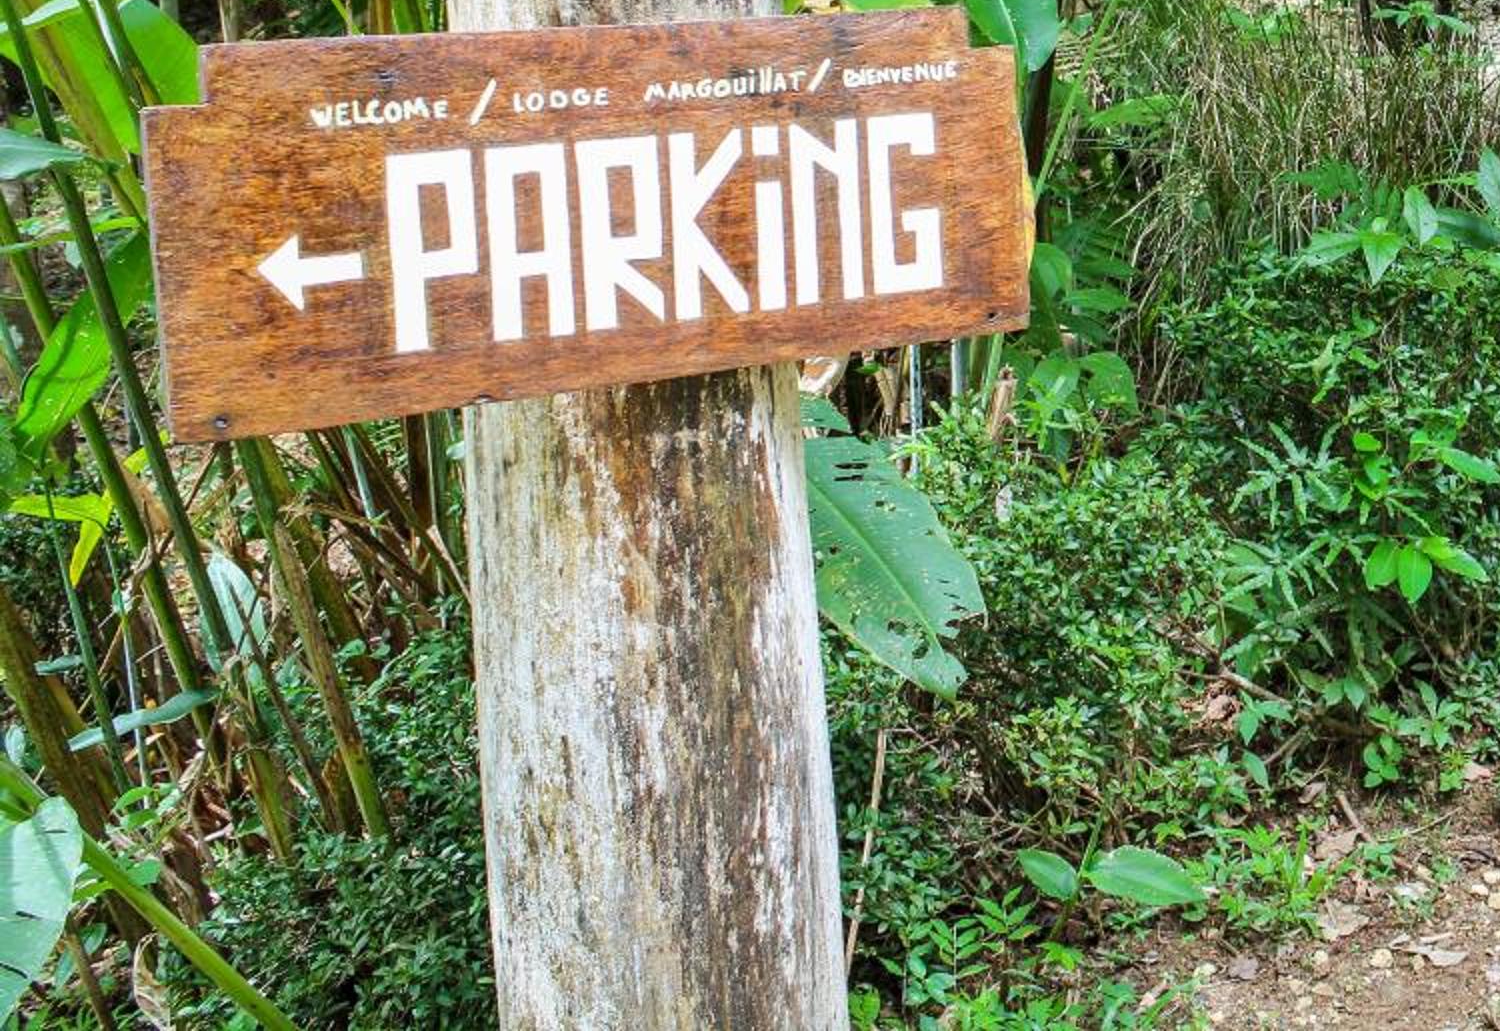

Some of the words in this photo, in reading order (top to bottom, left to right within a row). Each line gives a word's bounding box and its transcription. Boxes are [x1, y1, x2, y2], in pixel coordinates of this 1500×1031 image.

[309, 96, 449, 128] WELCOME
[513, 87, 609, 113] LODGE
[842, 61, 957, 88] BIENVENUE
